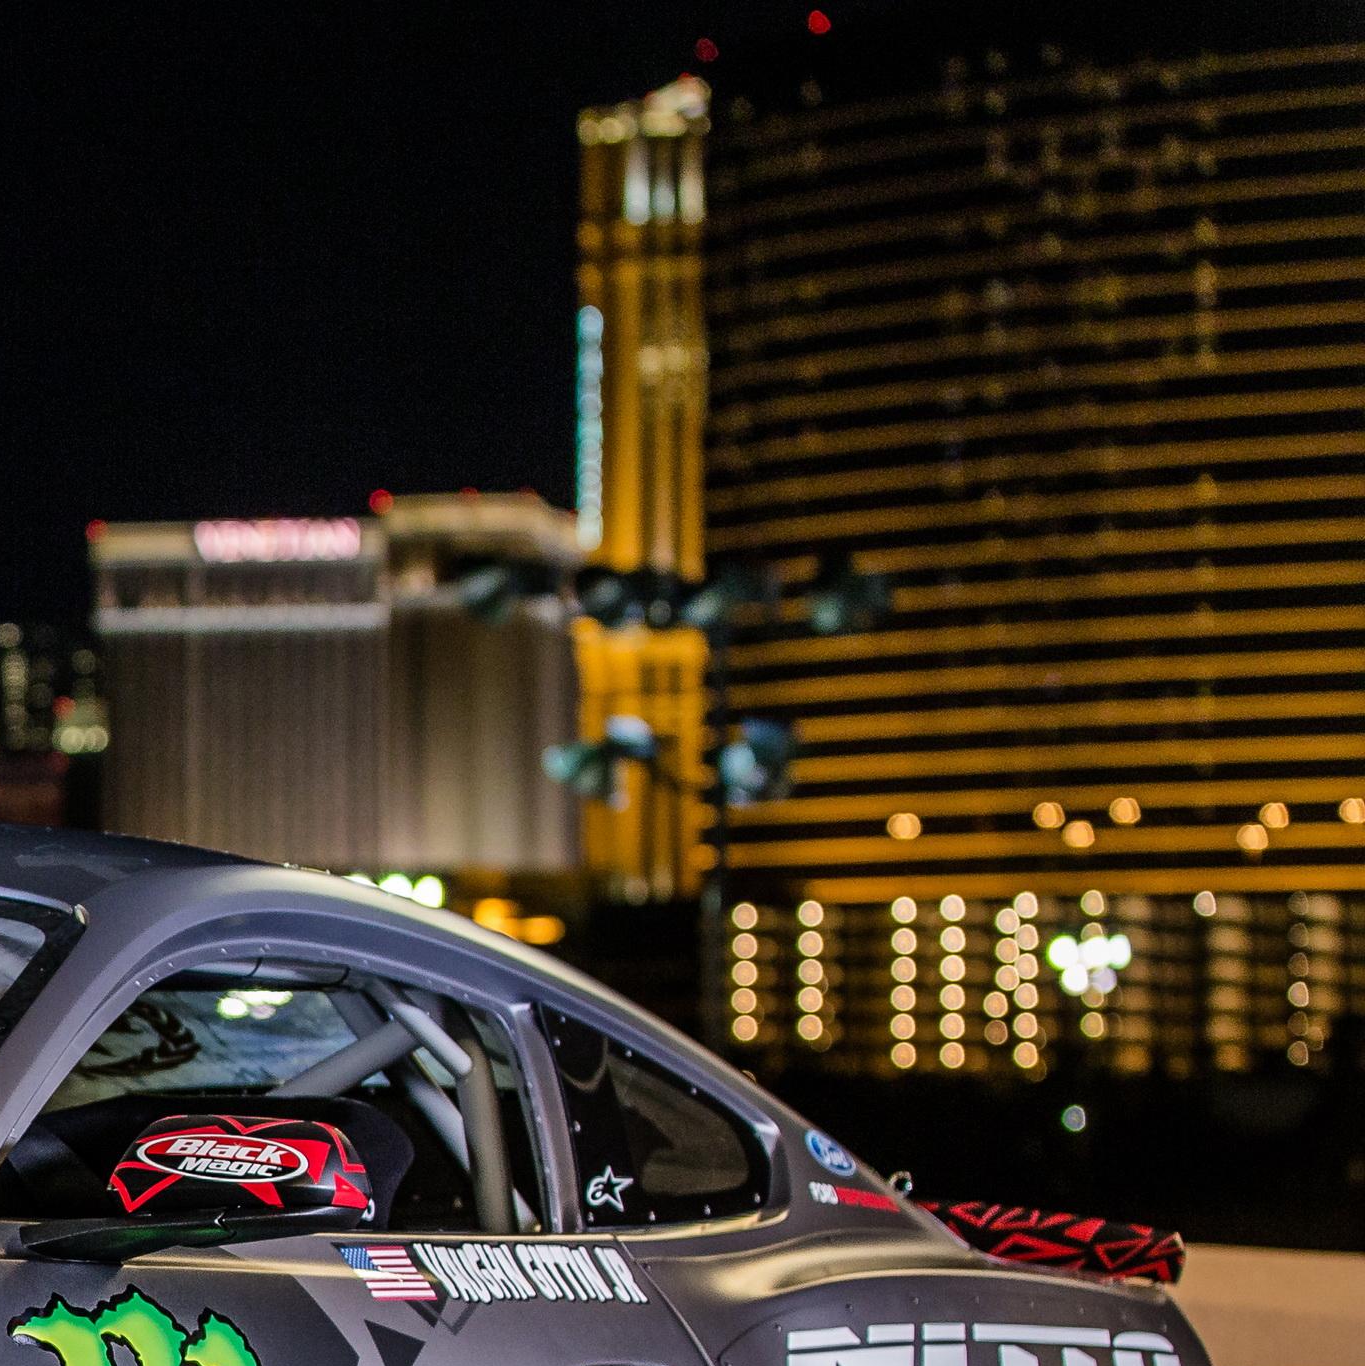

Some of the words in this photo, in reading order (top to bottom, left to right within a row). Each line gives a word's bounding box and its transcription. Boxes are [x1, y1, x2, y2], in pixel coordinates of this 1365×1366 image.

[165, 1138, 289, 1165] Black
[177, 1156, 279, 1177] Magic
[412, 1242, 537, 1304] VAUGHN
[515, 1243, 615, 1303] GITTIN
[594, 1245, 649, 1304] JR
